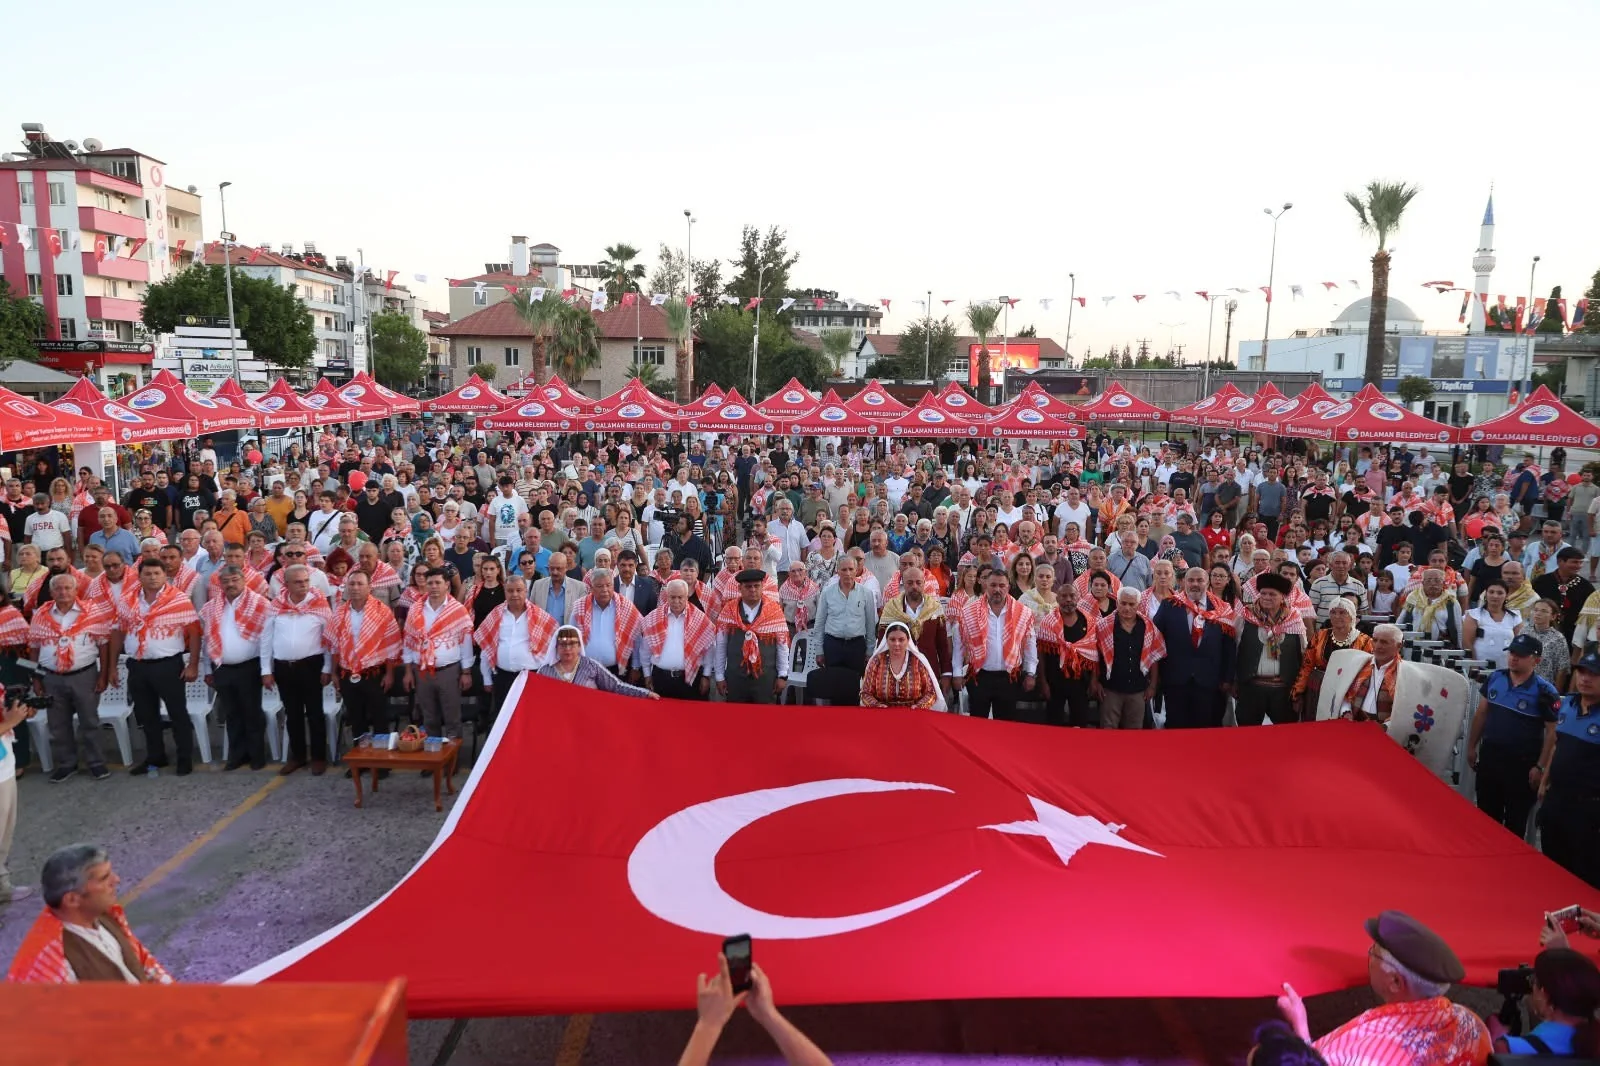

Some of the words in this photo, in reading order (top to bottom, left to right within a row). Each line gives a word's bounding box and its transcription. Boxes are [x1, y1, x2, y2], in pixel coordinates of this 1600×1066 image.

[1396, 432, 1437, 440] BELEDİYESİ
[1530, 434, 1580, 443] BELEDİYESİ
[33, 522, 54, 530] USPA
